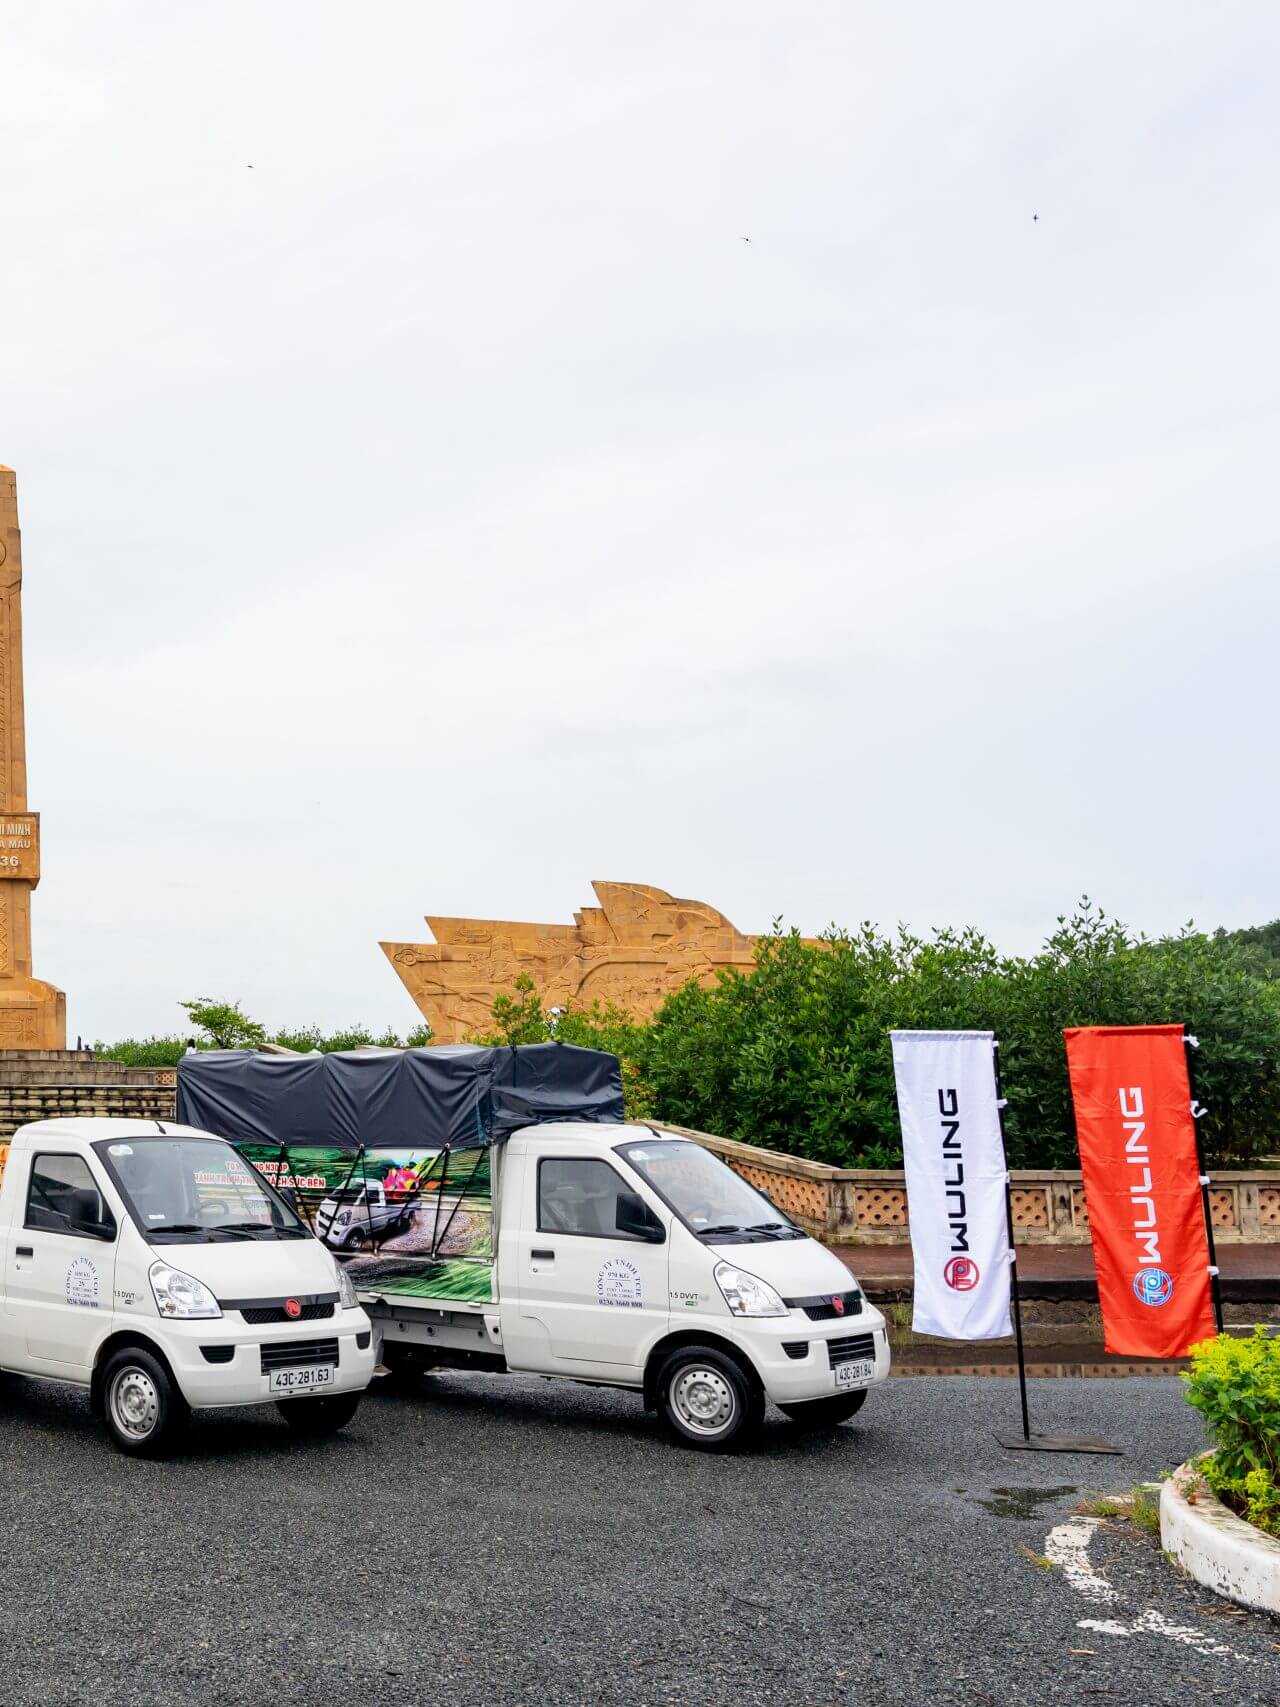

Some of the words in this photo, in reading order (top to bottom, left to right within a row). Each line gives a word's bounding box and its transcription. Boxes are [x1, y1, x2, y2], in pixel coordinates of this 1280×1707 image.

[6, 823, 31, 836] MINH
[8, 840, 31, 849] MAU
[938, 1088, 970, 1252] WULING
[1118, 1087, 1162, 1264] WULING
[275, 1369, 329, 1386] 43C-281.63
